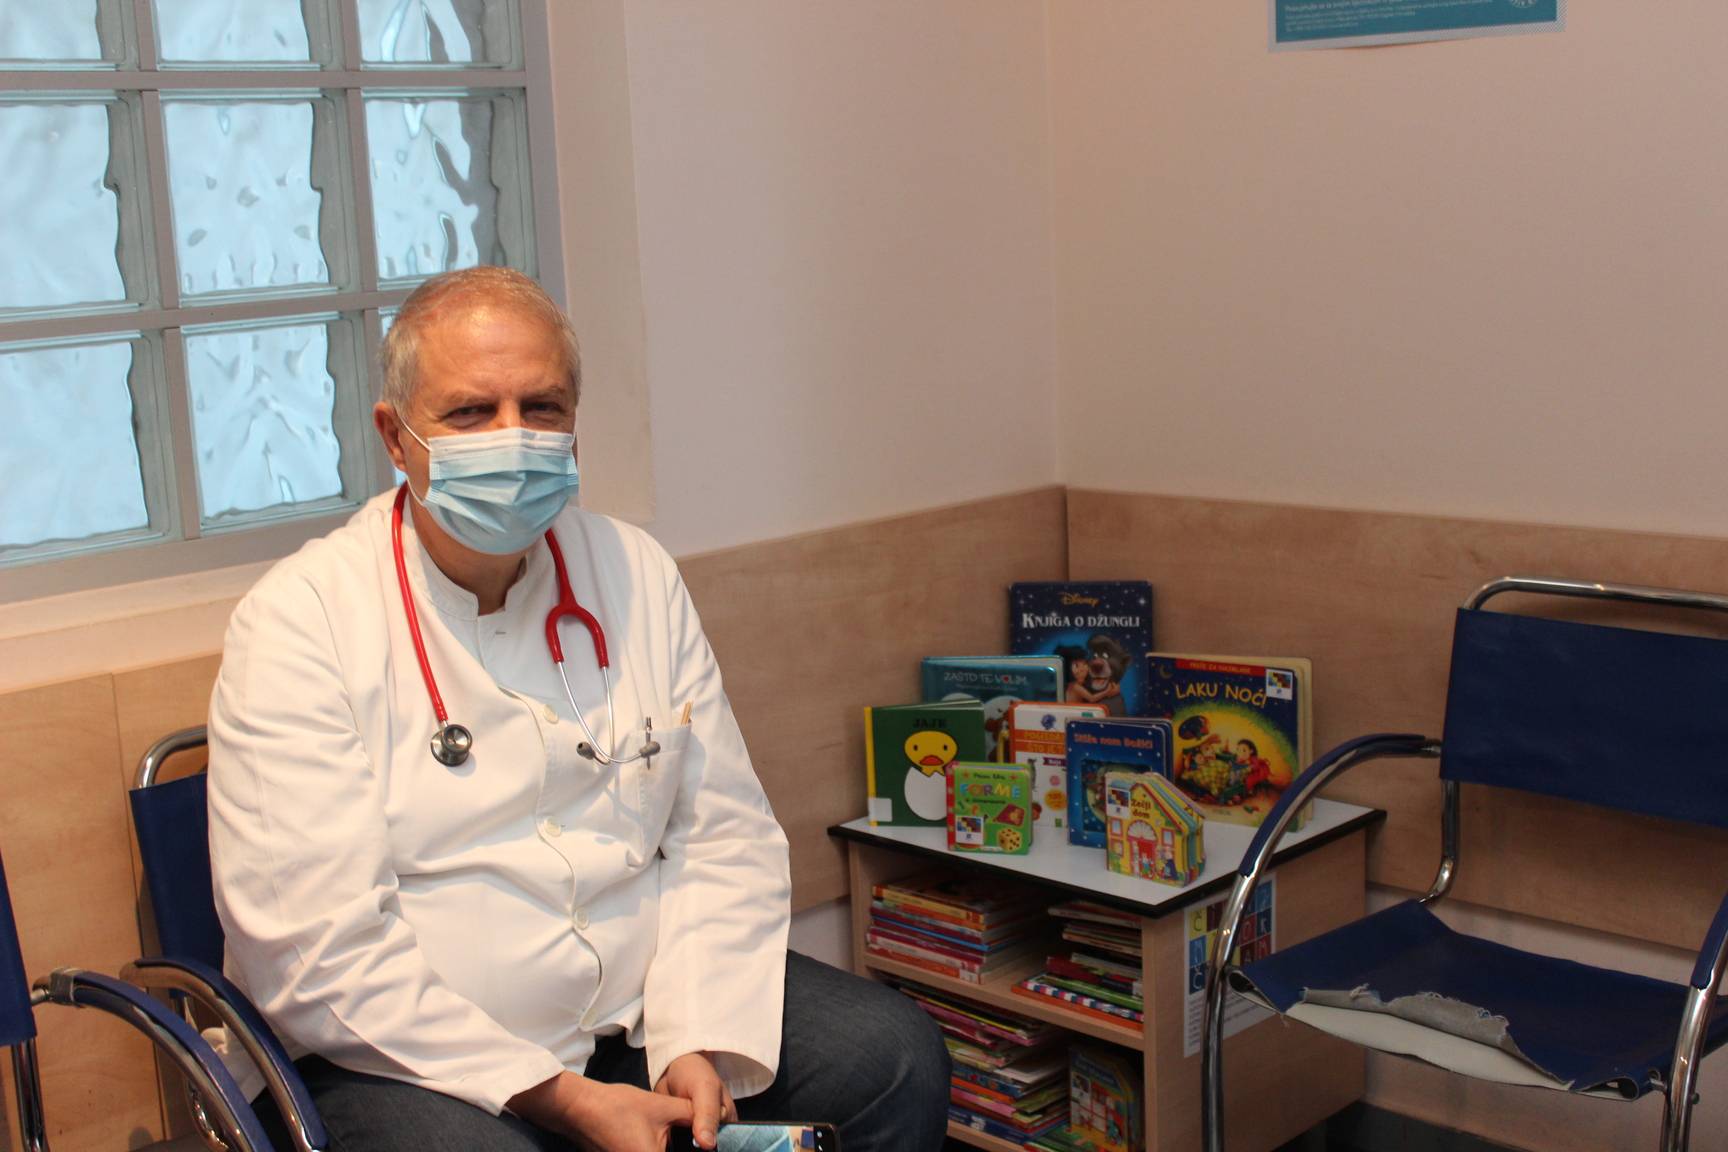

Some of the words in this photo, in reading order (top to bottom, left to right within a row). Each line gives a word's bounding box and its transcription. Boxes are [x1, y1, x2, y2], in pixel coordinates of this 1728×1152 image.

[1074, 616, 1084, 627] O
[1087, 613, 1140, 627] DŽUNGLI
[1175, 682, 1218, 699] LAKU
[960, 783, 1020, 800] FORME
